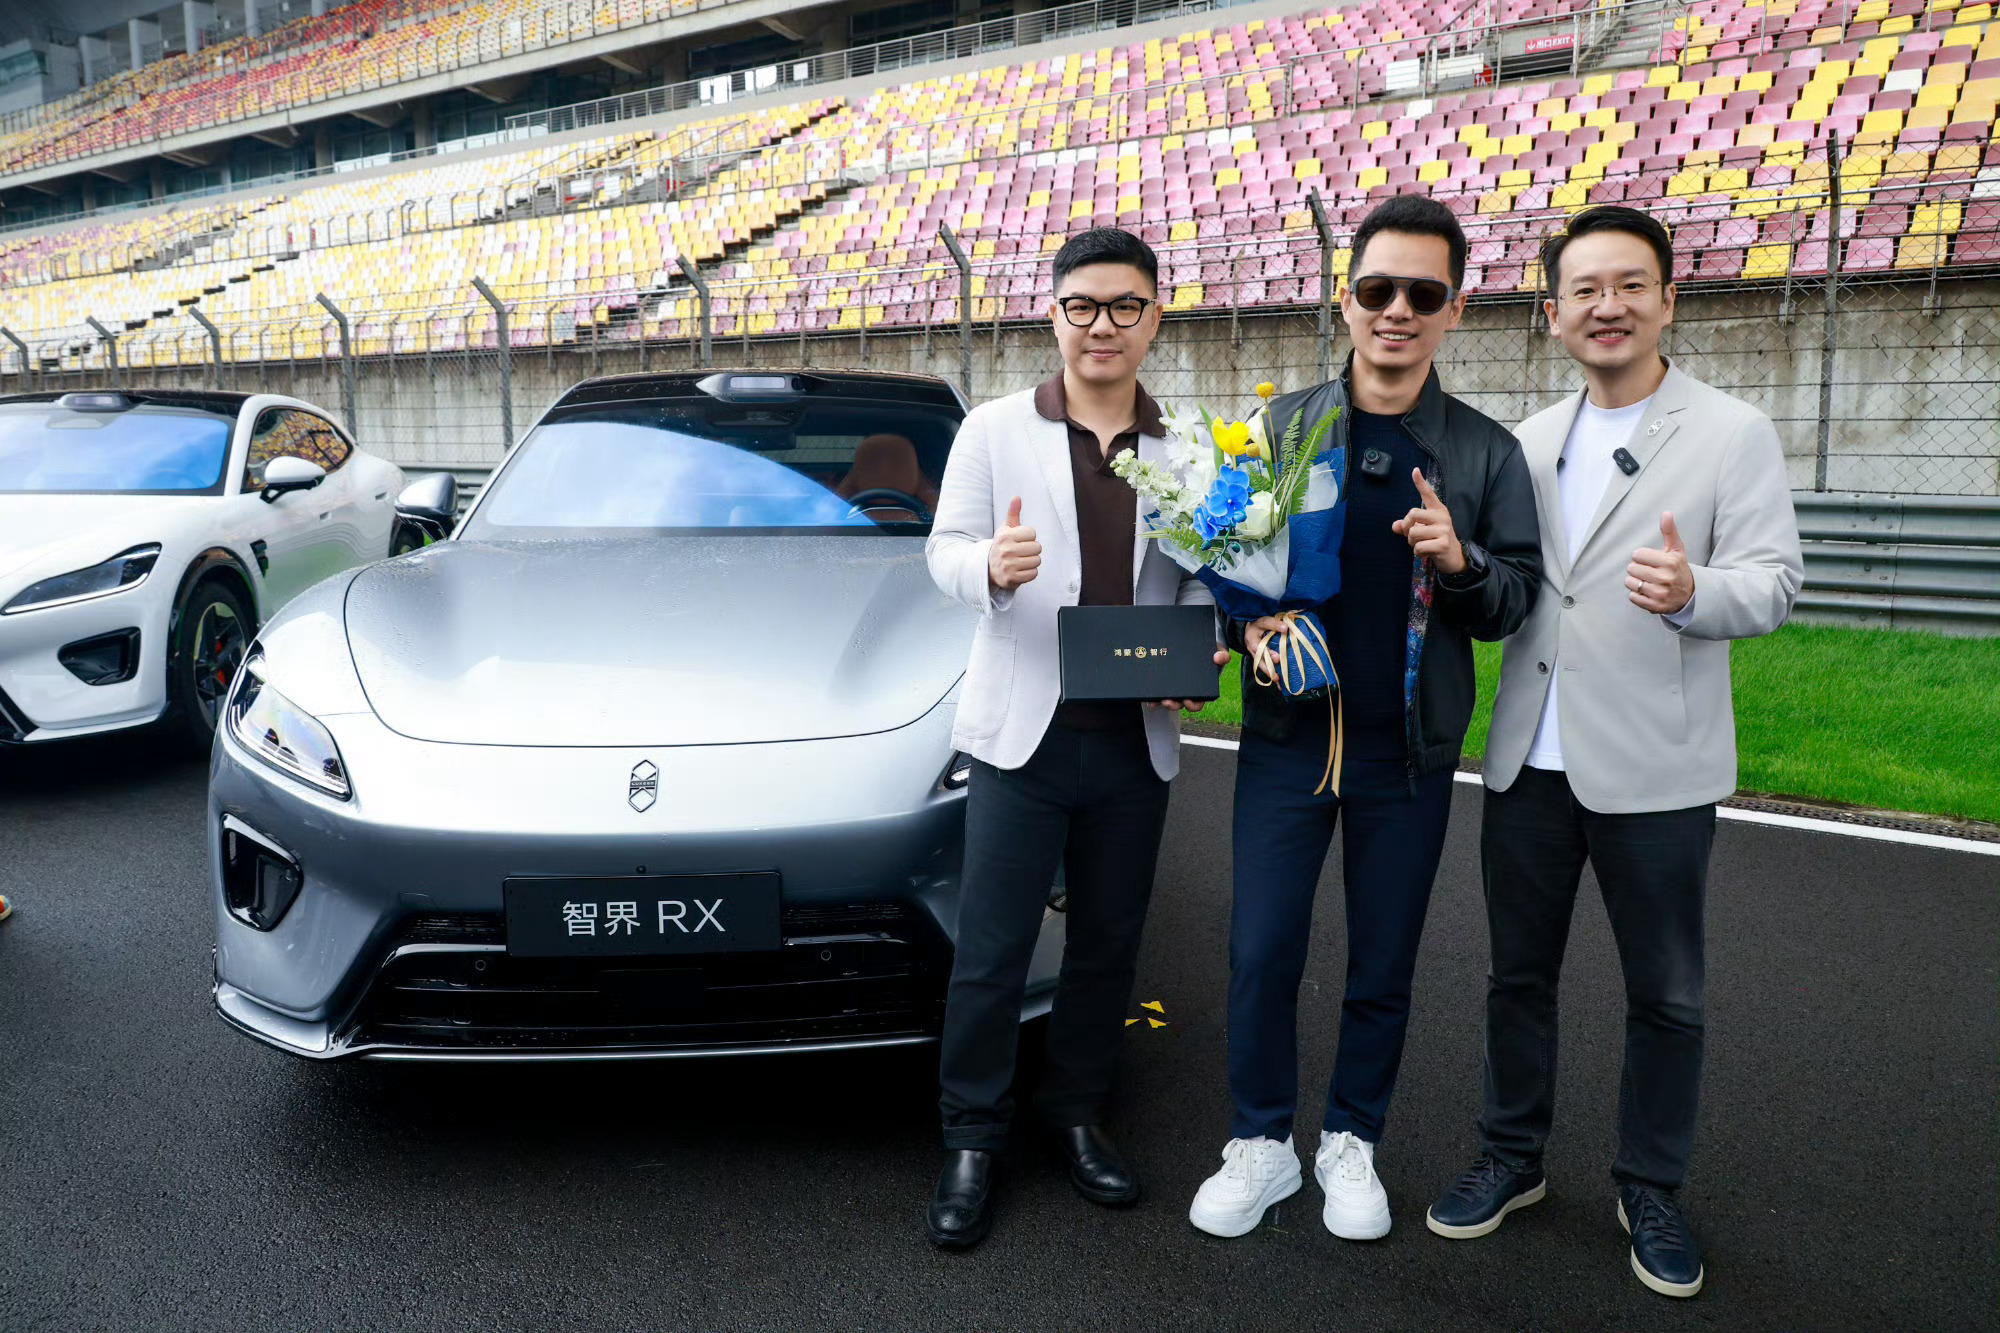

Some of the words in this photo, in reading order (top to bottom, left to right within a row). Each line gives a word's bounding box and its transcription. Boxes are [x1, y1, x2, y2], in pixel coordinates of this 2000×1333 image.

[1536, 39, 1552, 49] 出口
[1552, 36, 1571, 46] EXIT
[1114, 648, 1131, 656] 鸿蒙
[1150, 648, 1167, 656] 智行
[562, 900, 641, 937] 智界
[657, 898, 726, 934] RX
